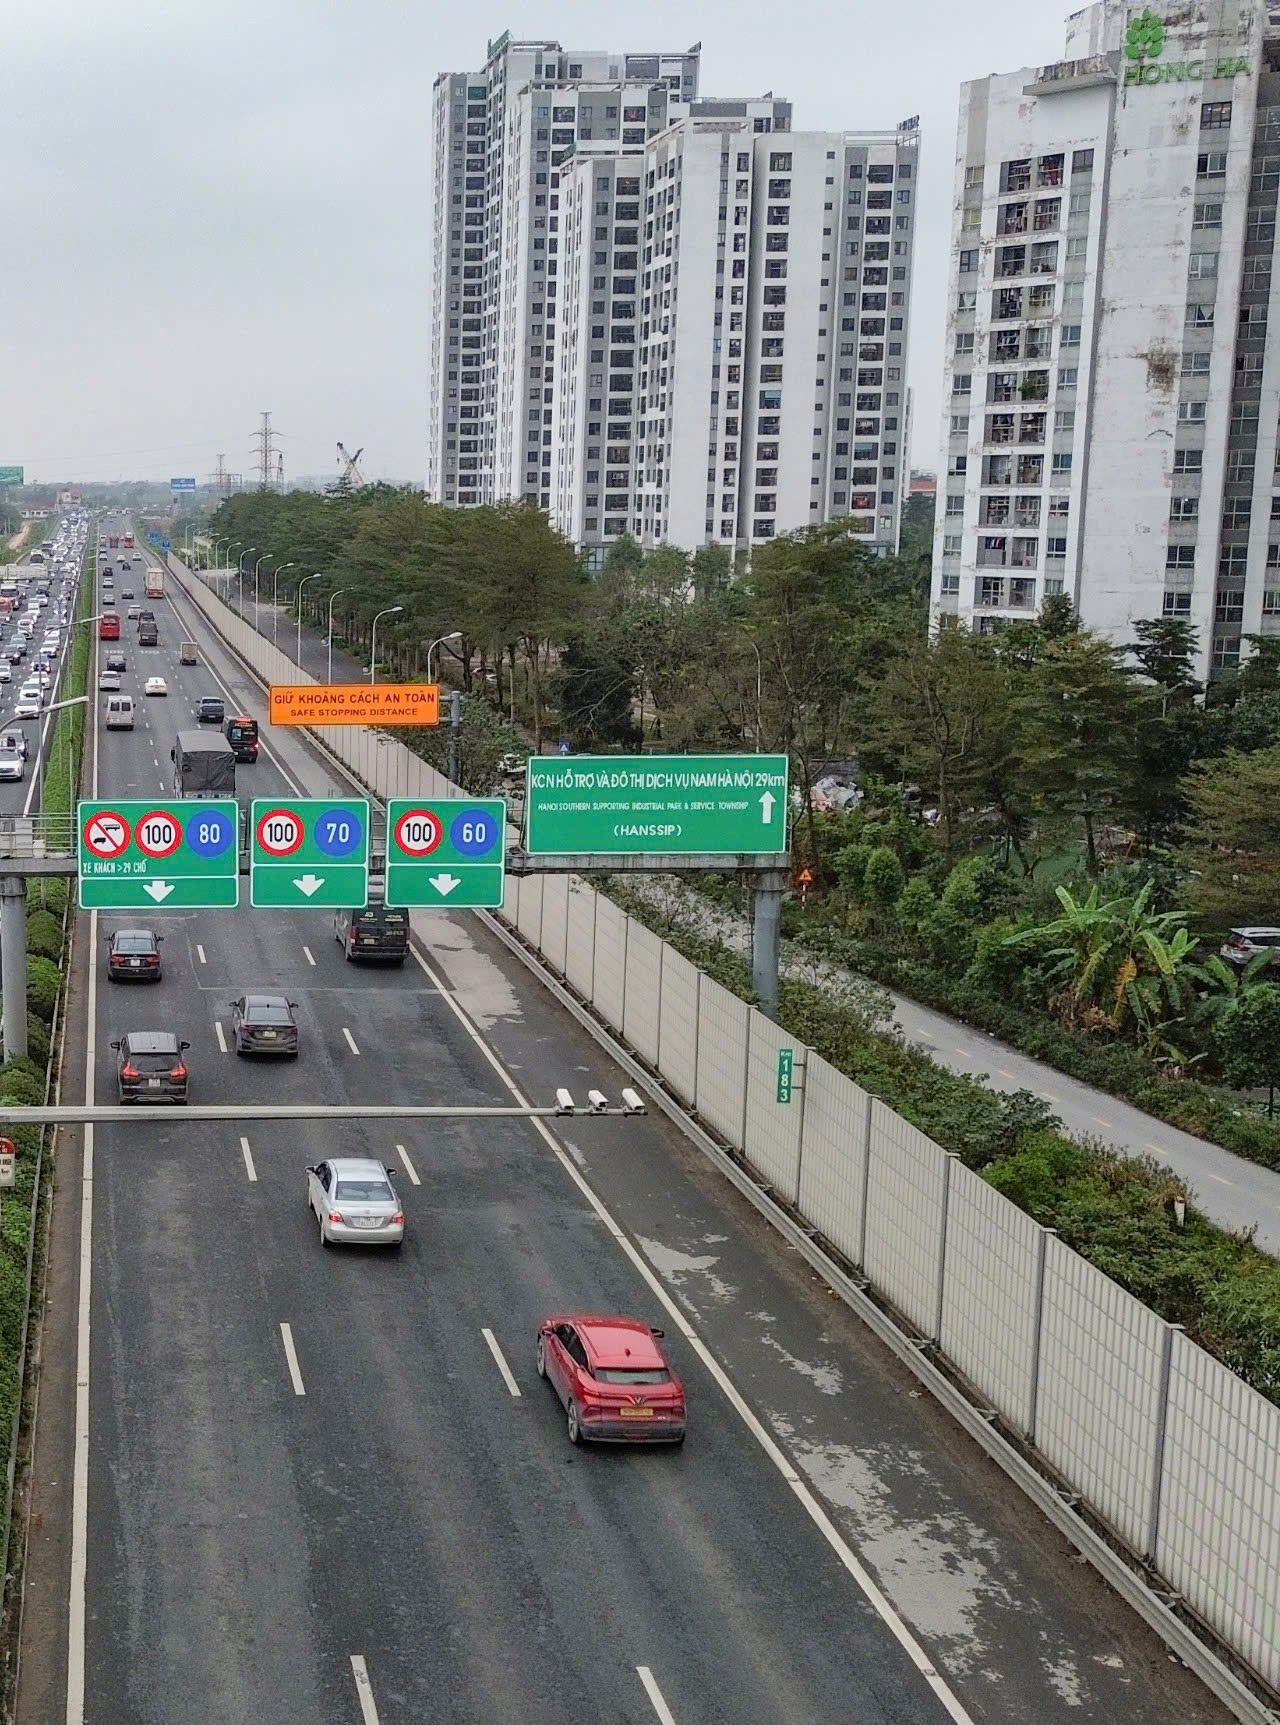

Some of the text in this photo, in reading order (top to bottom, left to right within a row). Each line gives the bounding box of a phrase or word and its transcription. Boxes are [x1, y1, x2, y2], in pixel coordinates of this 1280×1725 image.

[274, 691, 294, 704] GIỮ
[350, 691, 380, 704] CÁCH
[384, 693, 400, 703] AN
[405, 690, 435, 703] TOÀN
[291, 708, 418, 717] SAFE STOPPING DISTANCE
[531, 774, 554, 788] KCN
[574, 773, 595, 790] TRỢ
[596, 770, 610, 788] VÀ
[611, 771, 629, 788] ĐÔ
[630, 773, 645, 789] THỊ
[646, 773, 673, 789] DỊCH
[675, 773, 689, 789] VỤ
[690, 773, 717, 787] NAM
[718, 769, 733, 787] HÀ
[735, 770, 754, 789] NỘI
[592, 802, 630, 810] SUPPORTING
[632, 802, 665, 810] INDUSTRIAL
[690, 802, 715, 810] SERVICE
[144, 823, 220, 844] 100 80
[267, 822, 350, 843] 100 70
[405, 822, 486, 843] 100 60
[82, 862, 91, 873] XE
[123, 862, 131, 873] 29
